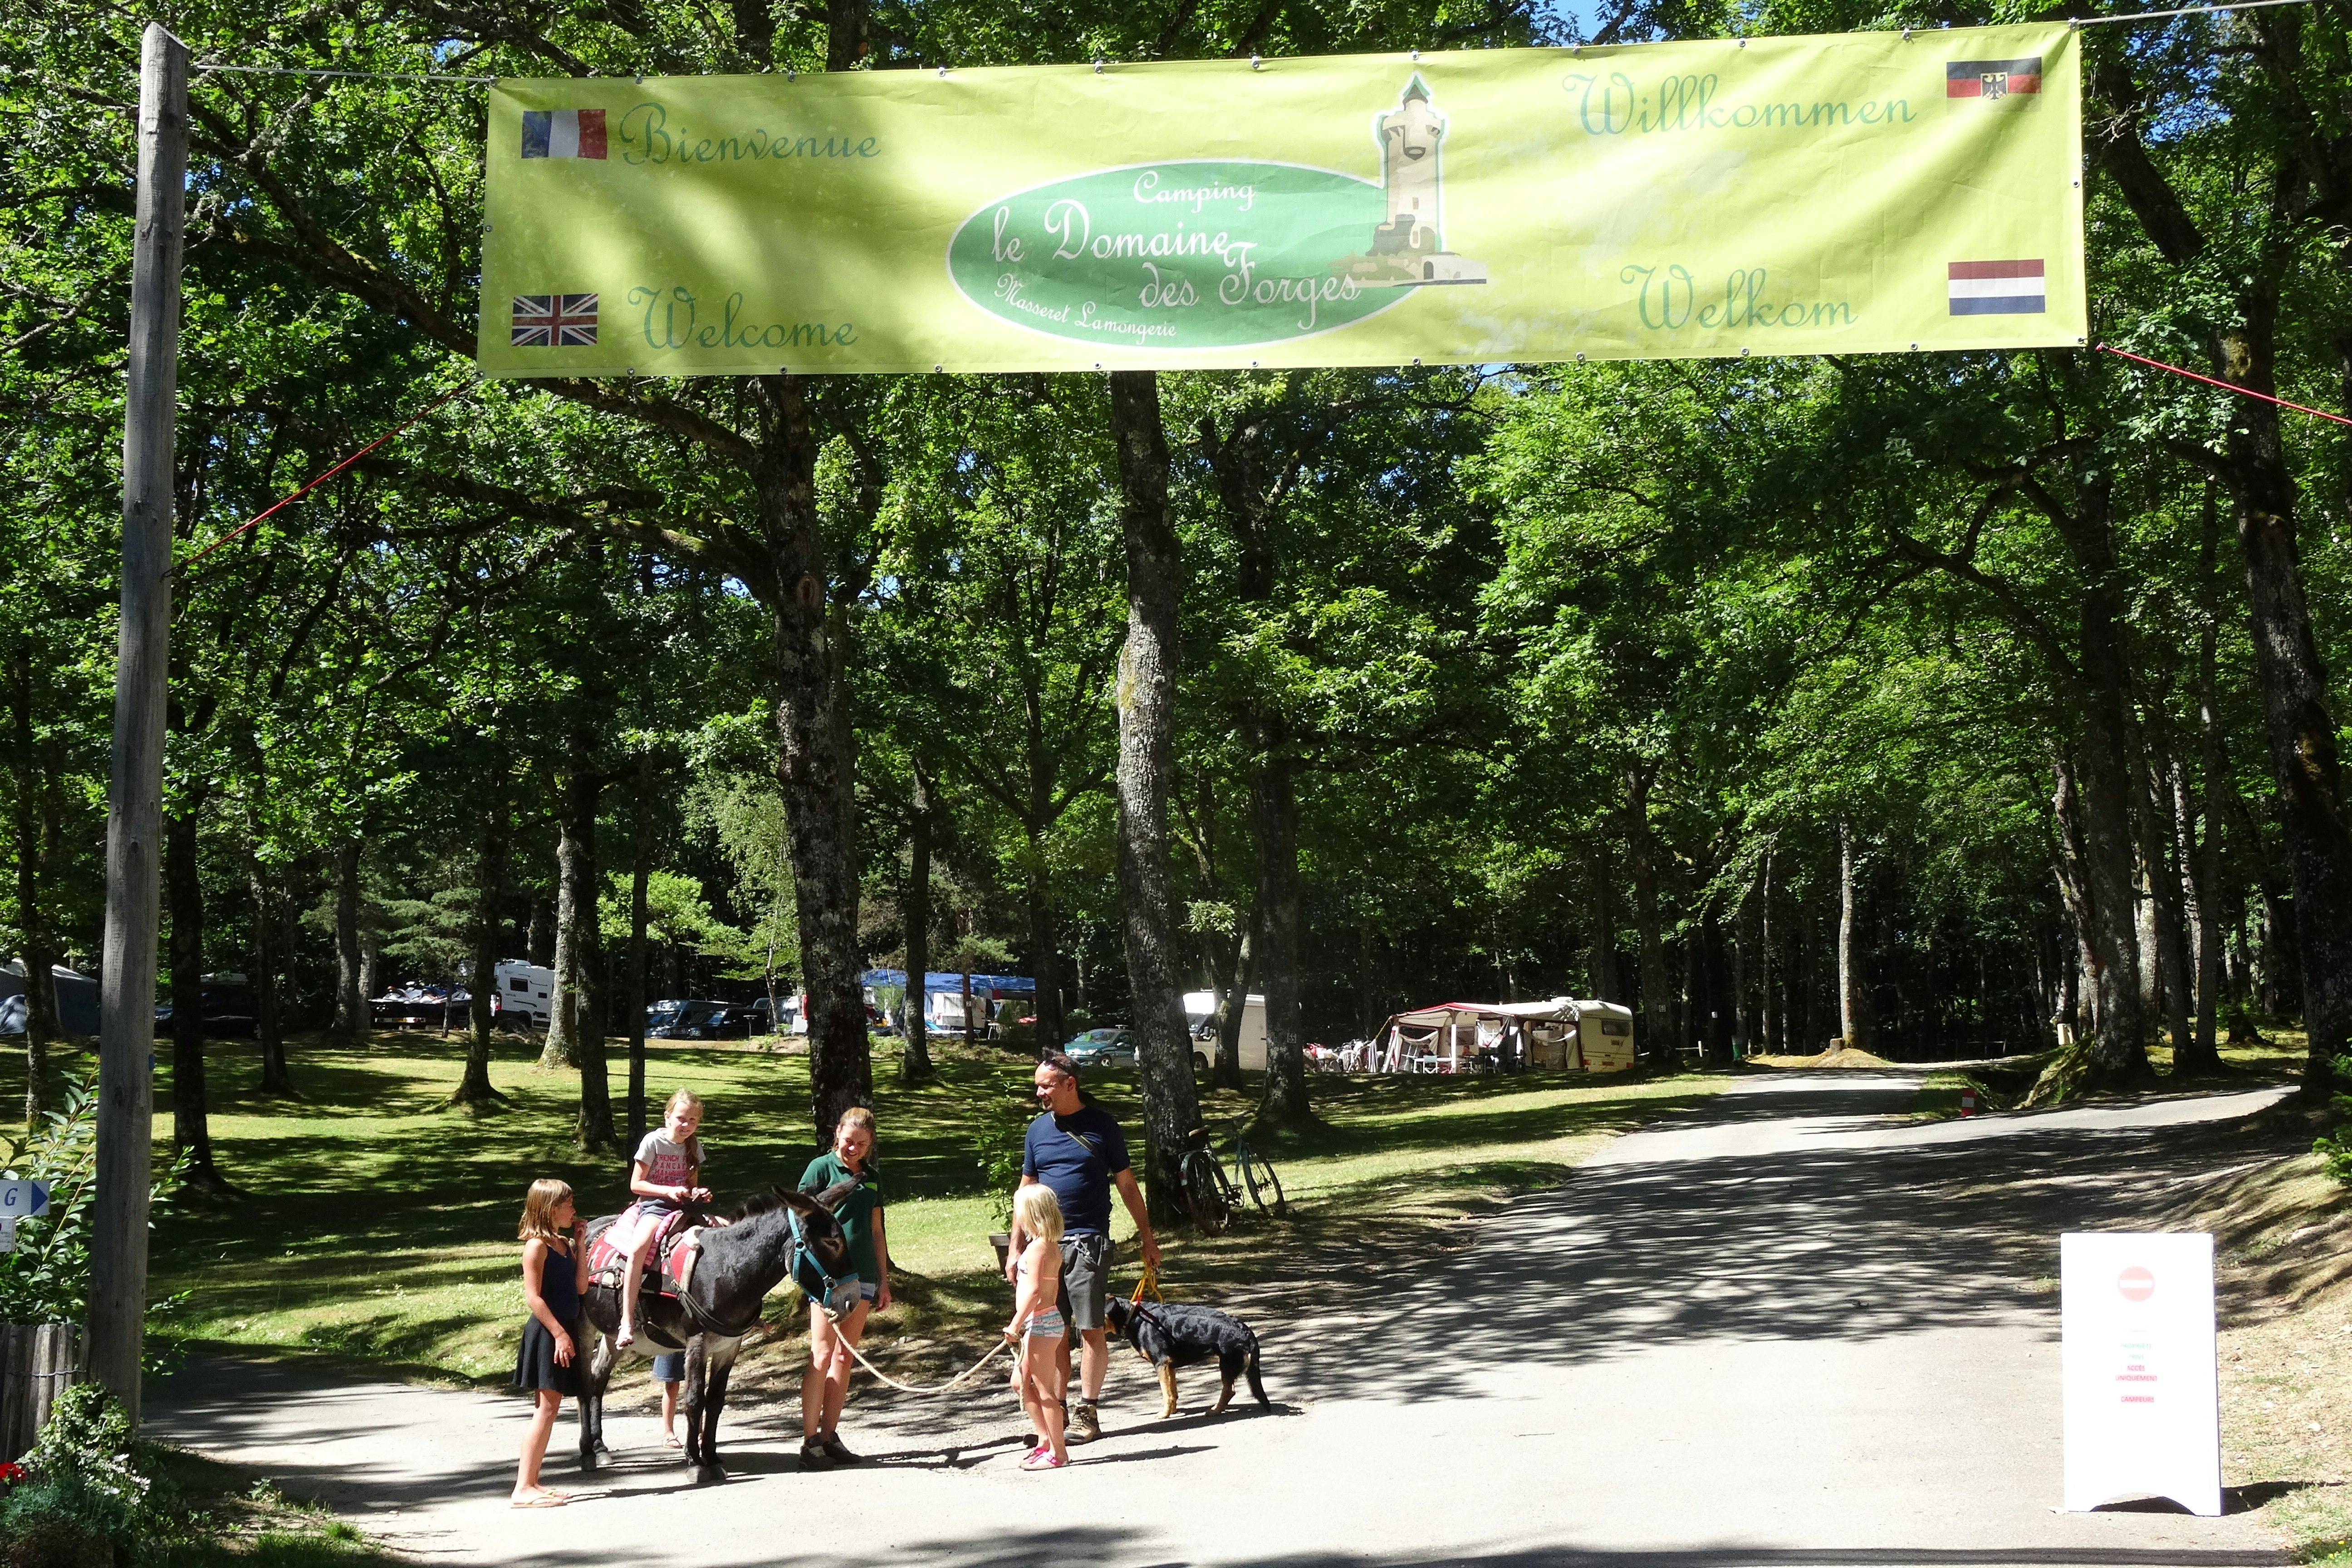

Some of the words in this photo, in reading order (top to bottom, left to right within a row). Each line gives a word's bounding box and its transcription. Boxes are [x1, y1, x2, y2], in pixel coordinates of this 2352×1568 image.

[619, 103, 881, 165] Bienvenue
[1562, 72, 1917, 136] Willkommen
[1134, 171, 1256, 212] Camping
[991, 206, 1024, 262] le
[1044, 199, 1227, 261] Domaine
[995, 274, 1069, 323] Masseret
[1074, 302, 1176, 345] Lamongerie
[1139, 263, 1199, 308] des
[1219, 241, 1362, 329] Forges
[1620, 264, 1858, 330] Welkom
[628, 287, 858, 348] Welcome
[4, 1187, 18, 1206] G
